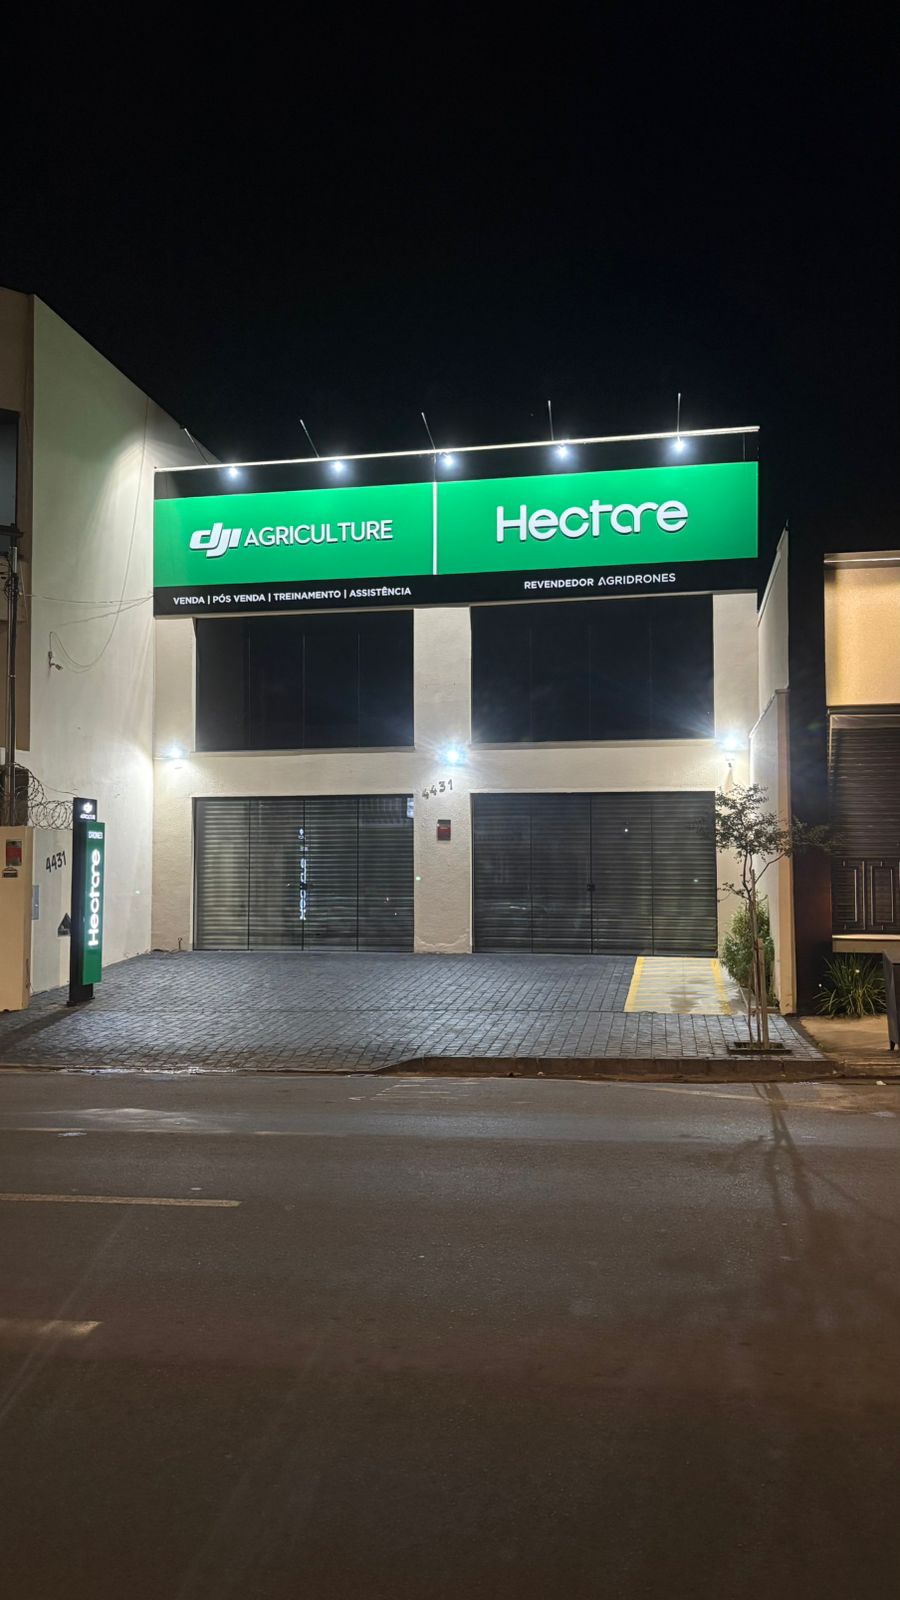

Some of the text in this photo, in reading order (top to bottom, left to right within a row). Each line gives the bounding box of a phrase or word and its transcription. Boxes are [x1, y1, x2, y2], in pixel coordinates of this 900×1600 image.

[496, 500, 688, 542] Hectare
[244, 520, 393, 547] AGRICULTURE
[524, 573, 676, 590] REVENDEDOR AGRIDRONES
[173, 586, 412, 605] VENDA PÓS VENDA TREINAMENTO ASSISTÊNCIA
[422, 779, 453, 800] 4431
[46, 851, 66, 872] 4431
[88, 848, 101, 947] Hectare
